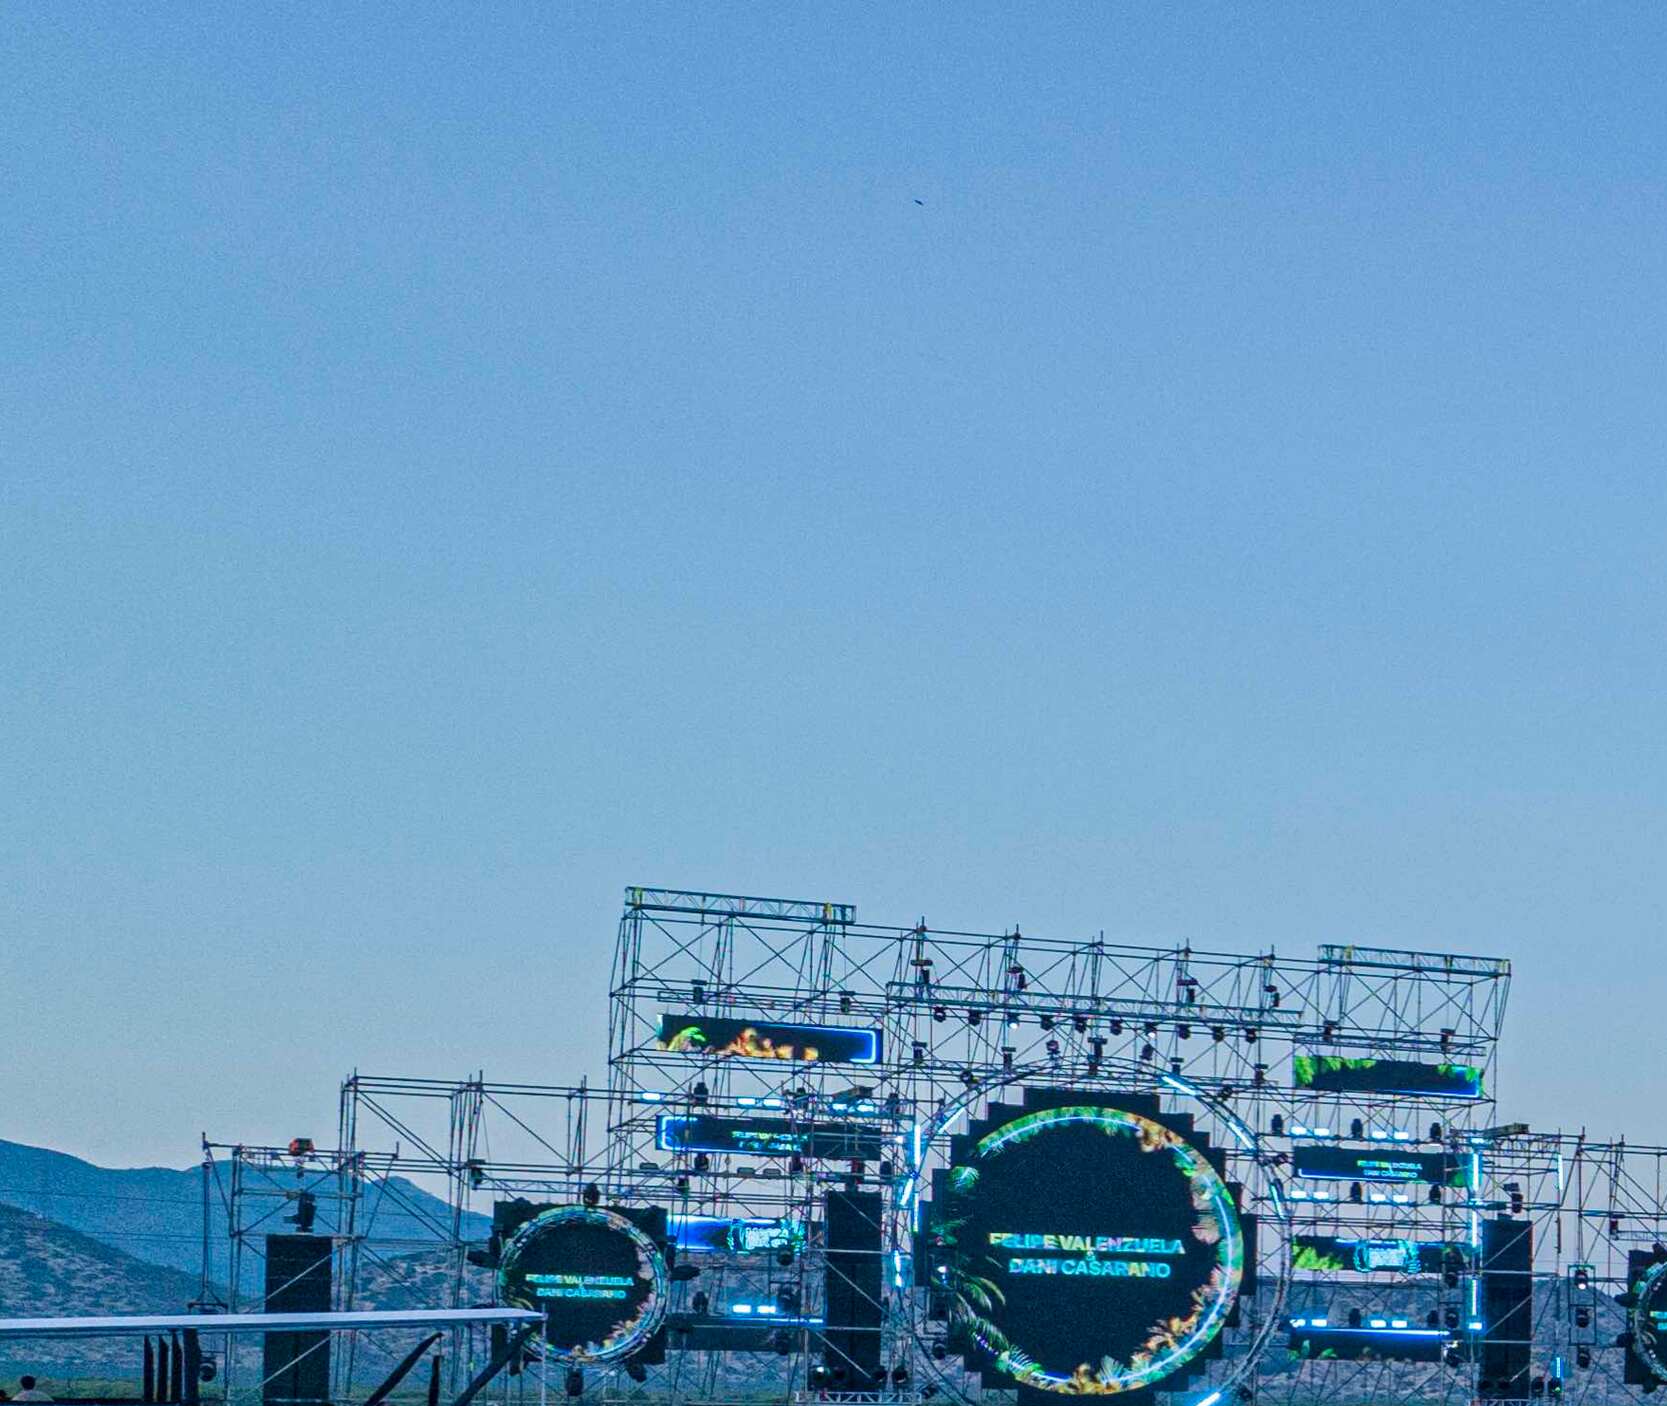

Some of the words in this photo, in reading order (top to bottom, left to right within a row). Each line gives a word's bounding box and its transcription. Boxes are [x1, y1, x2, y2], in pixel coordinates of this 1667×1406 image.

[989, 1232, 1058, 1250] FELIPE
[1059, 1234, 1186, 1254] VALENZUELA
[1008, 1258, 1057, 1274] DANI
[1061, 1260, 1171, 1278] CASARANO
